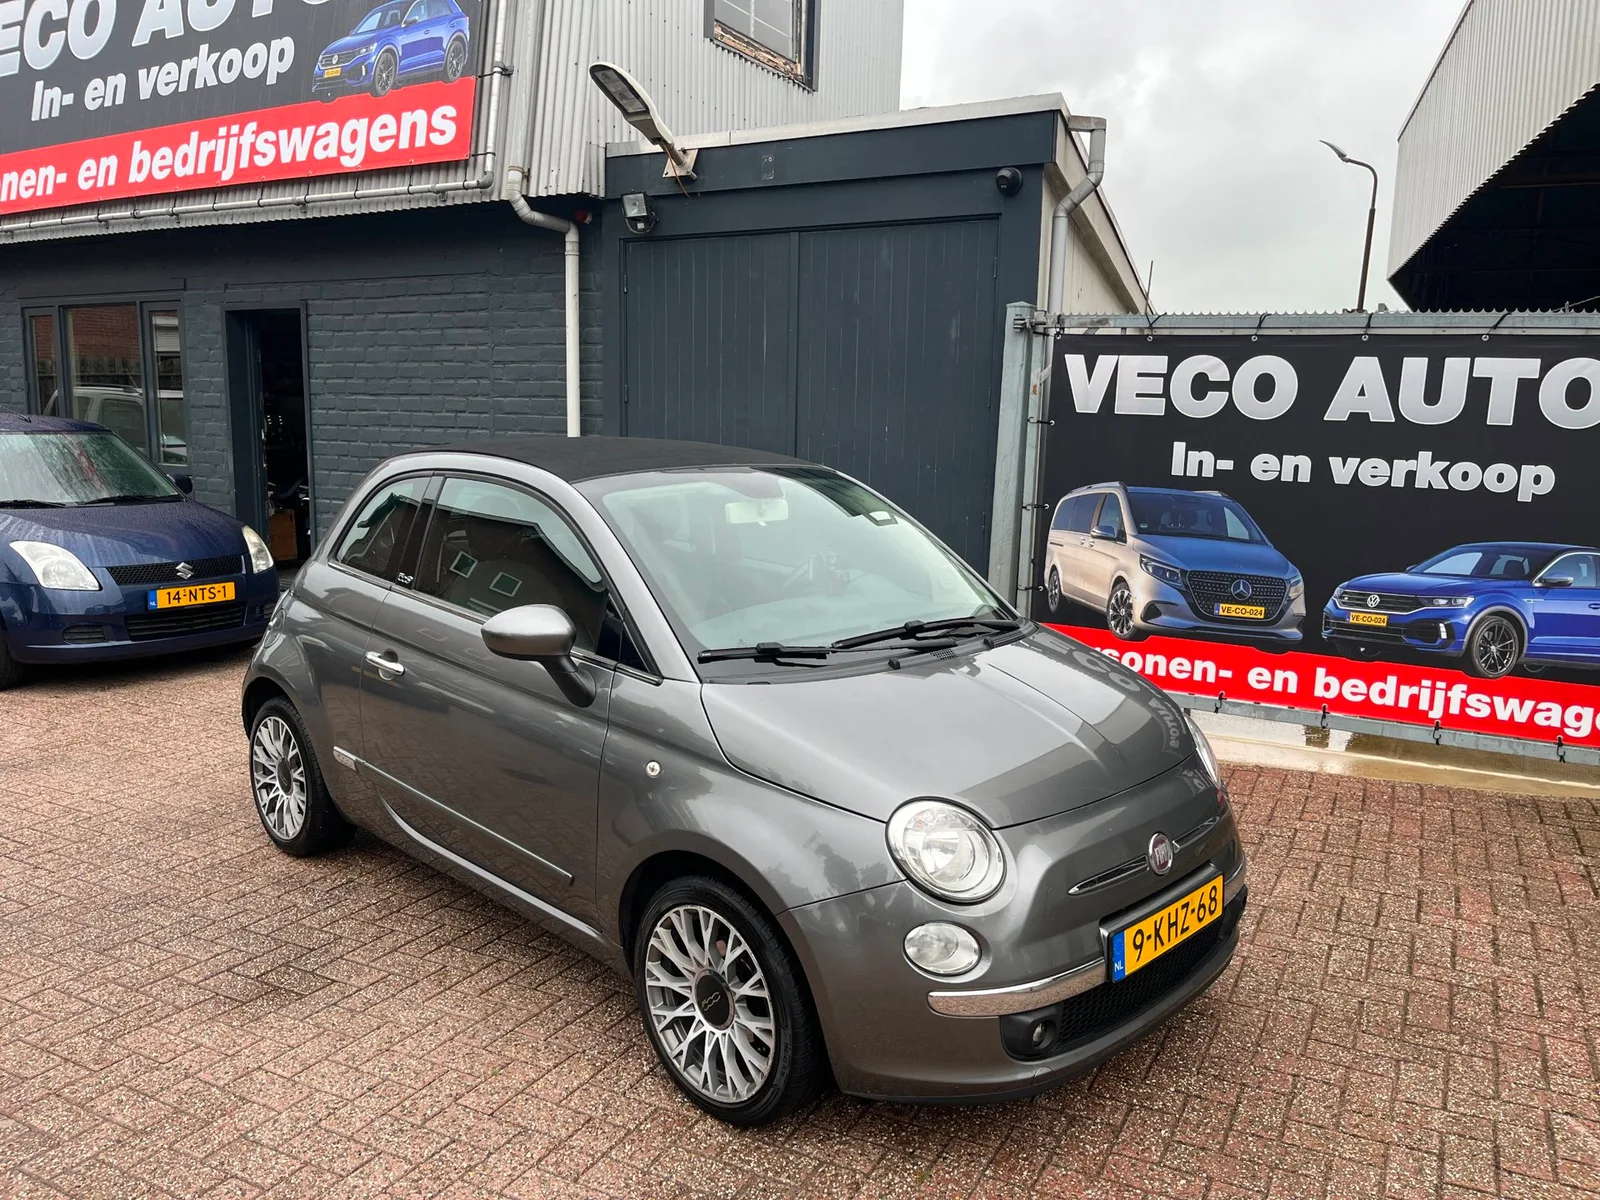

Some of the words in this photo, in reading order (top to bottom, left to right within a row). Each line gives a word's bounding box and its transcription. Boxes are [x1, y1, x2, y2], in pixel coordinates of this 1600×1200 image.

[31, 79, 74, 121] In-
[84, 72, 126, 111] en
[138, 36, 295, 100] verkoop
[78, 154, 118, 190] en
[128, 105, 457, 183] bedrijfswagens
[1064, 354, 1299, 421] VECO
[1323, 356, 1600, 430] AUTO
[1171, 441, 1234, 478] In-
[1250, 452, 1312, 483] en
[1328, 451, 1556, 502] verkoop
[166, 585, 227, 605] 14-NTS-1
[1220, 606, 1263, 617] VE-CO-024
[1351, 614, 1386, 624] VE-CO-024
[1247, 666, 1298, 694] en
[1314, 667, 1600, 738] bedrijfswag
[1132, 885, 1218, 963] 9-KHZ-68
[1114, 961, 1124, 973] NL
